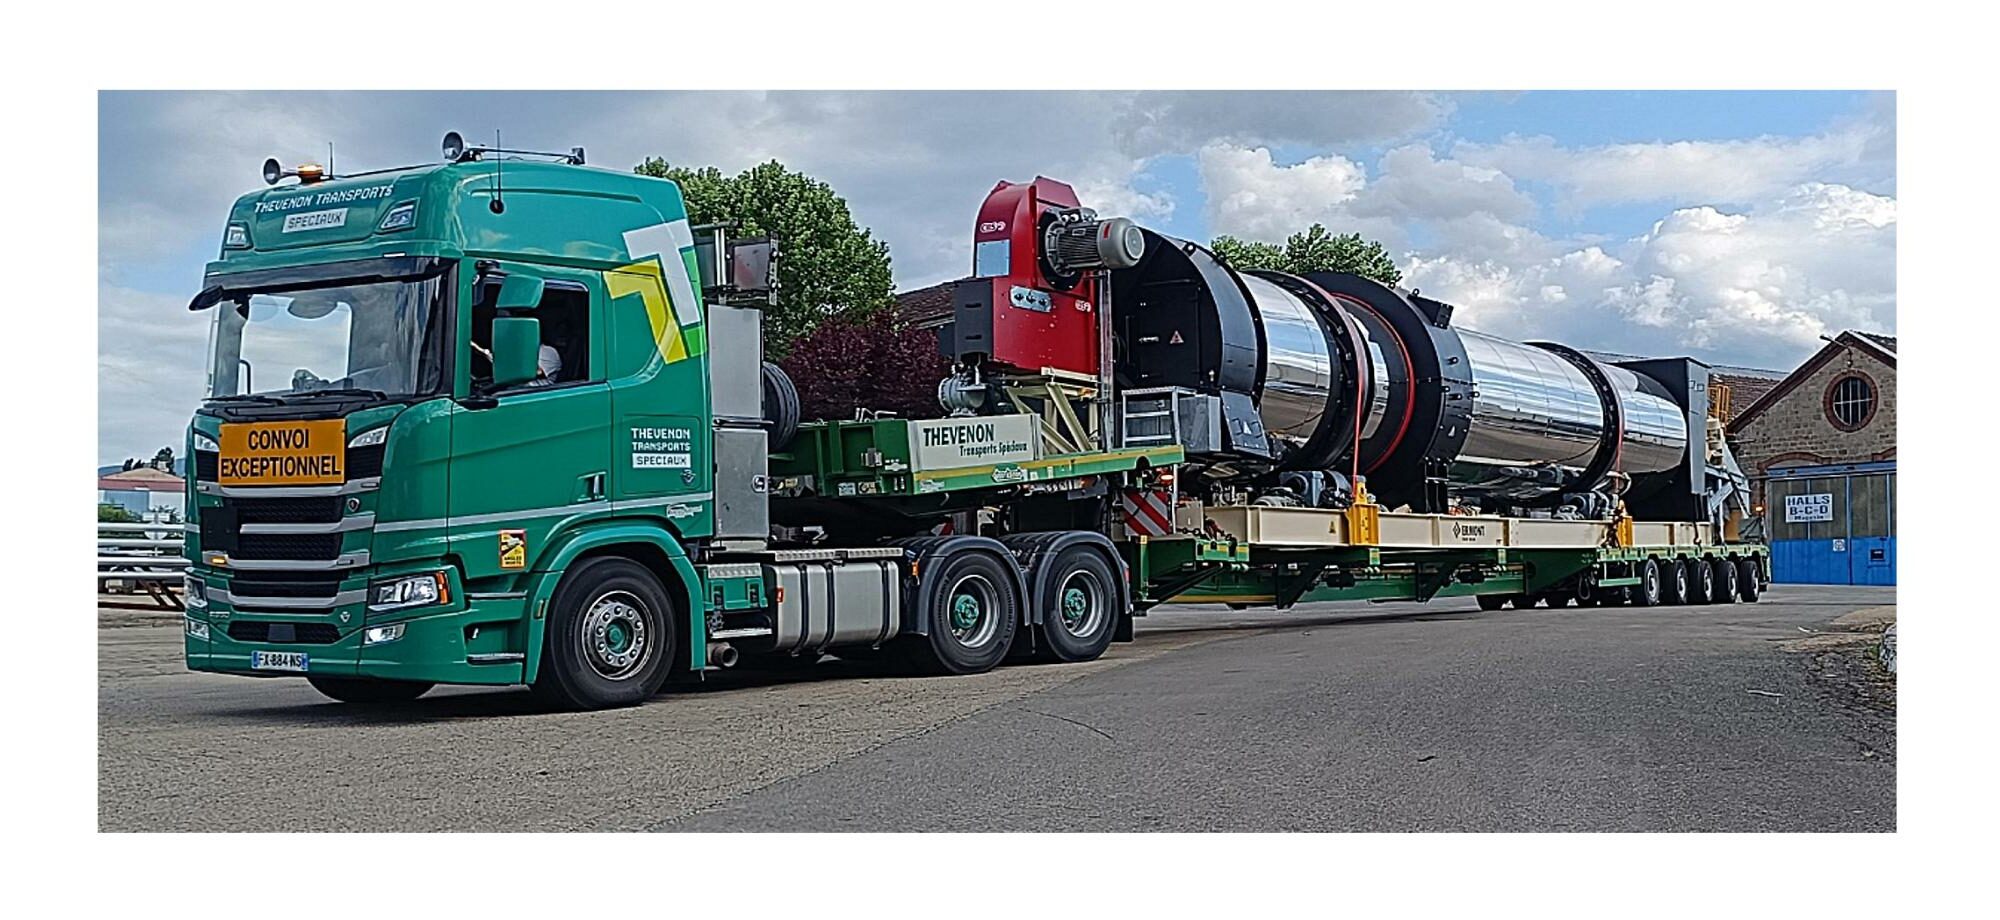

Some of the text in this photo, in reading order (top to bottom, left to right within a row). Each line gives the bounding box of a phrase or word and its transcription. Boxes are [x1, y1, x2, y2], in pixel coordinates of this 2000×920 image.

[254, 184, 394, 213] THEVENON TRANSPORTS
[288, 213, 342, 229] SPECIAUX
[248, 428, 309, 450] CONVOI
[631, 427, 690, 439] THEVENON
[923, 424, 994, 447] THEVENON
[632, 441, 691, 451] TRANSPORTS
[960, 442, 998, 458] Transports
[221, 455, 342, 478] EXCEPTIONNEL
[636, 455, 687, 465] SPECIAUX
[1787, 495, 1830, 506] HALLS
